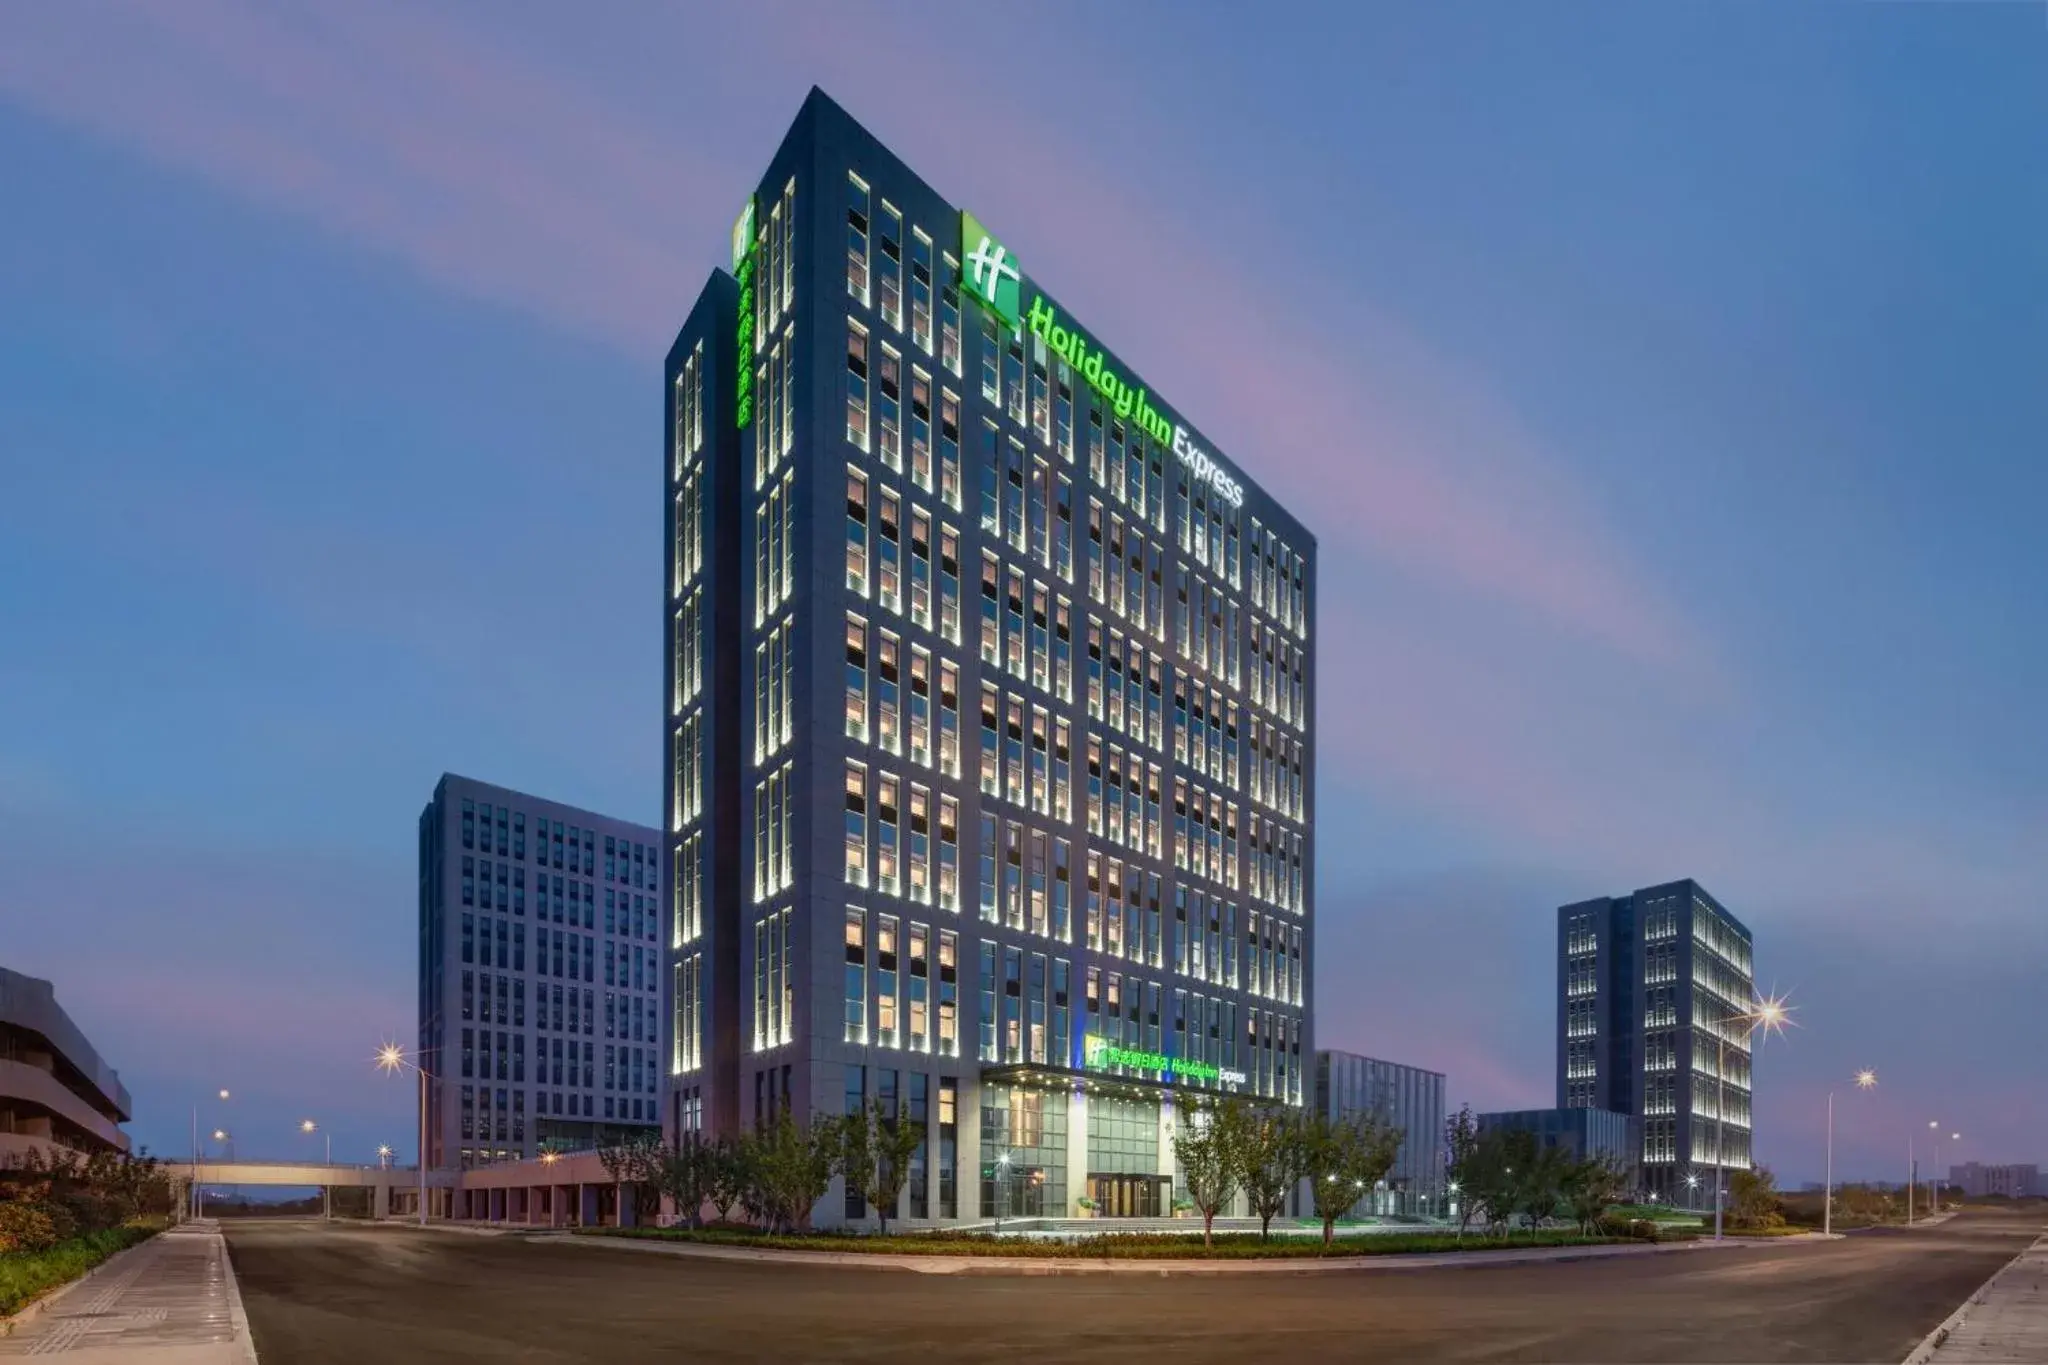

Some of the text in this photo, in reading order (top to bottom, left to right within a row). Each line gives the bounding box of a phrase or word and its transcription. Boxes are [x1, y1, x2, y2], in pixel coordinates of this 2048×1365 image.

[1027, 294, 1244, 509] Holiday Inn Express
[1172, 1058, 1205, 1080] Holiday
[1219, 1067, 1246, 1083] Express
